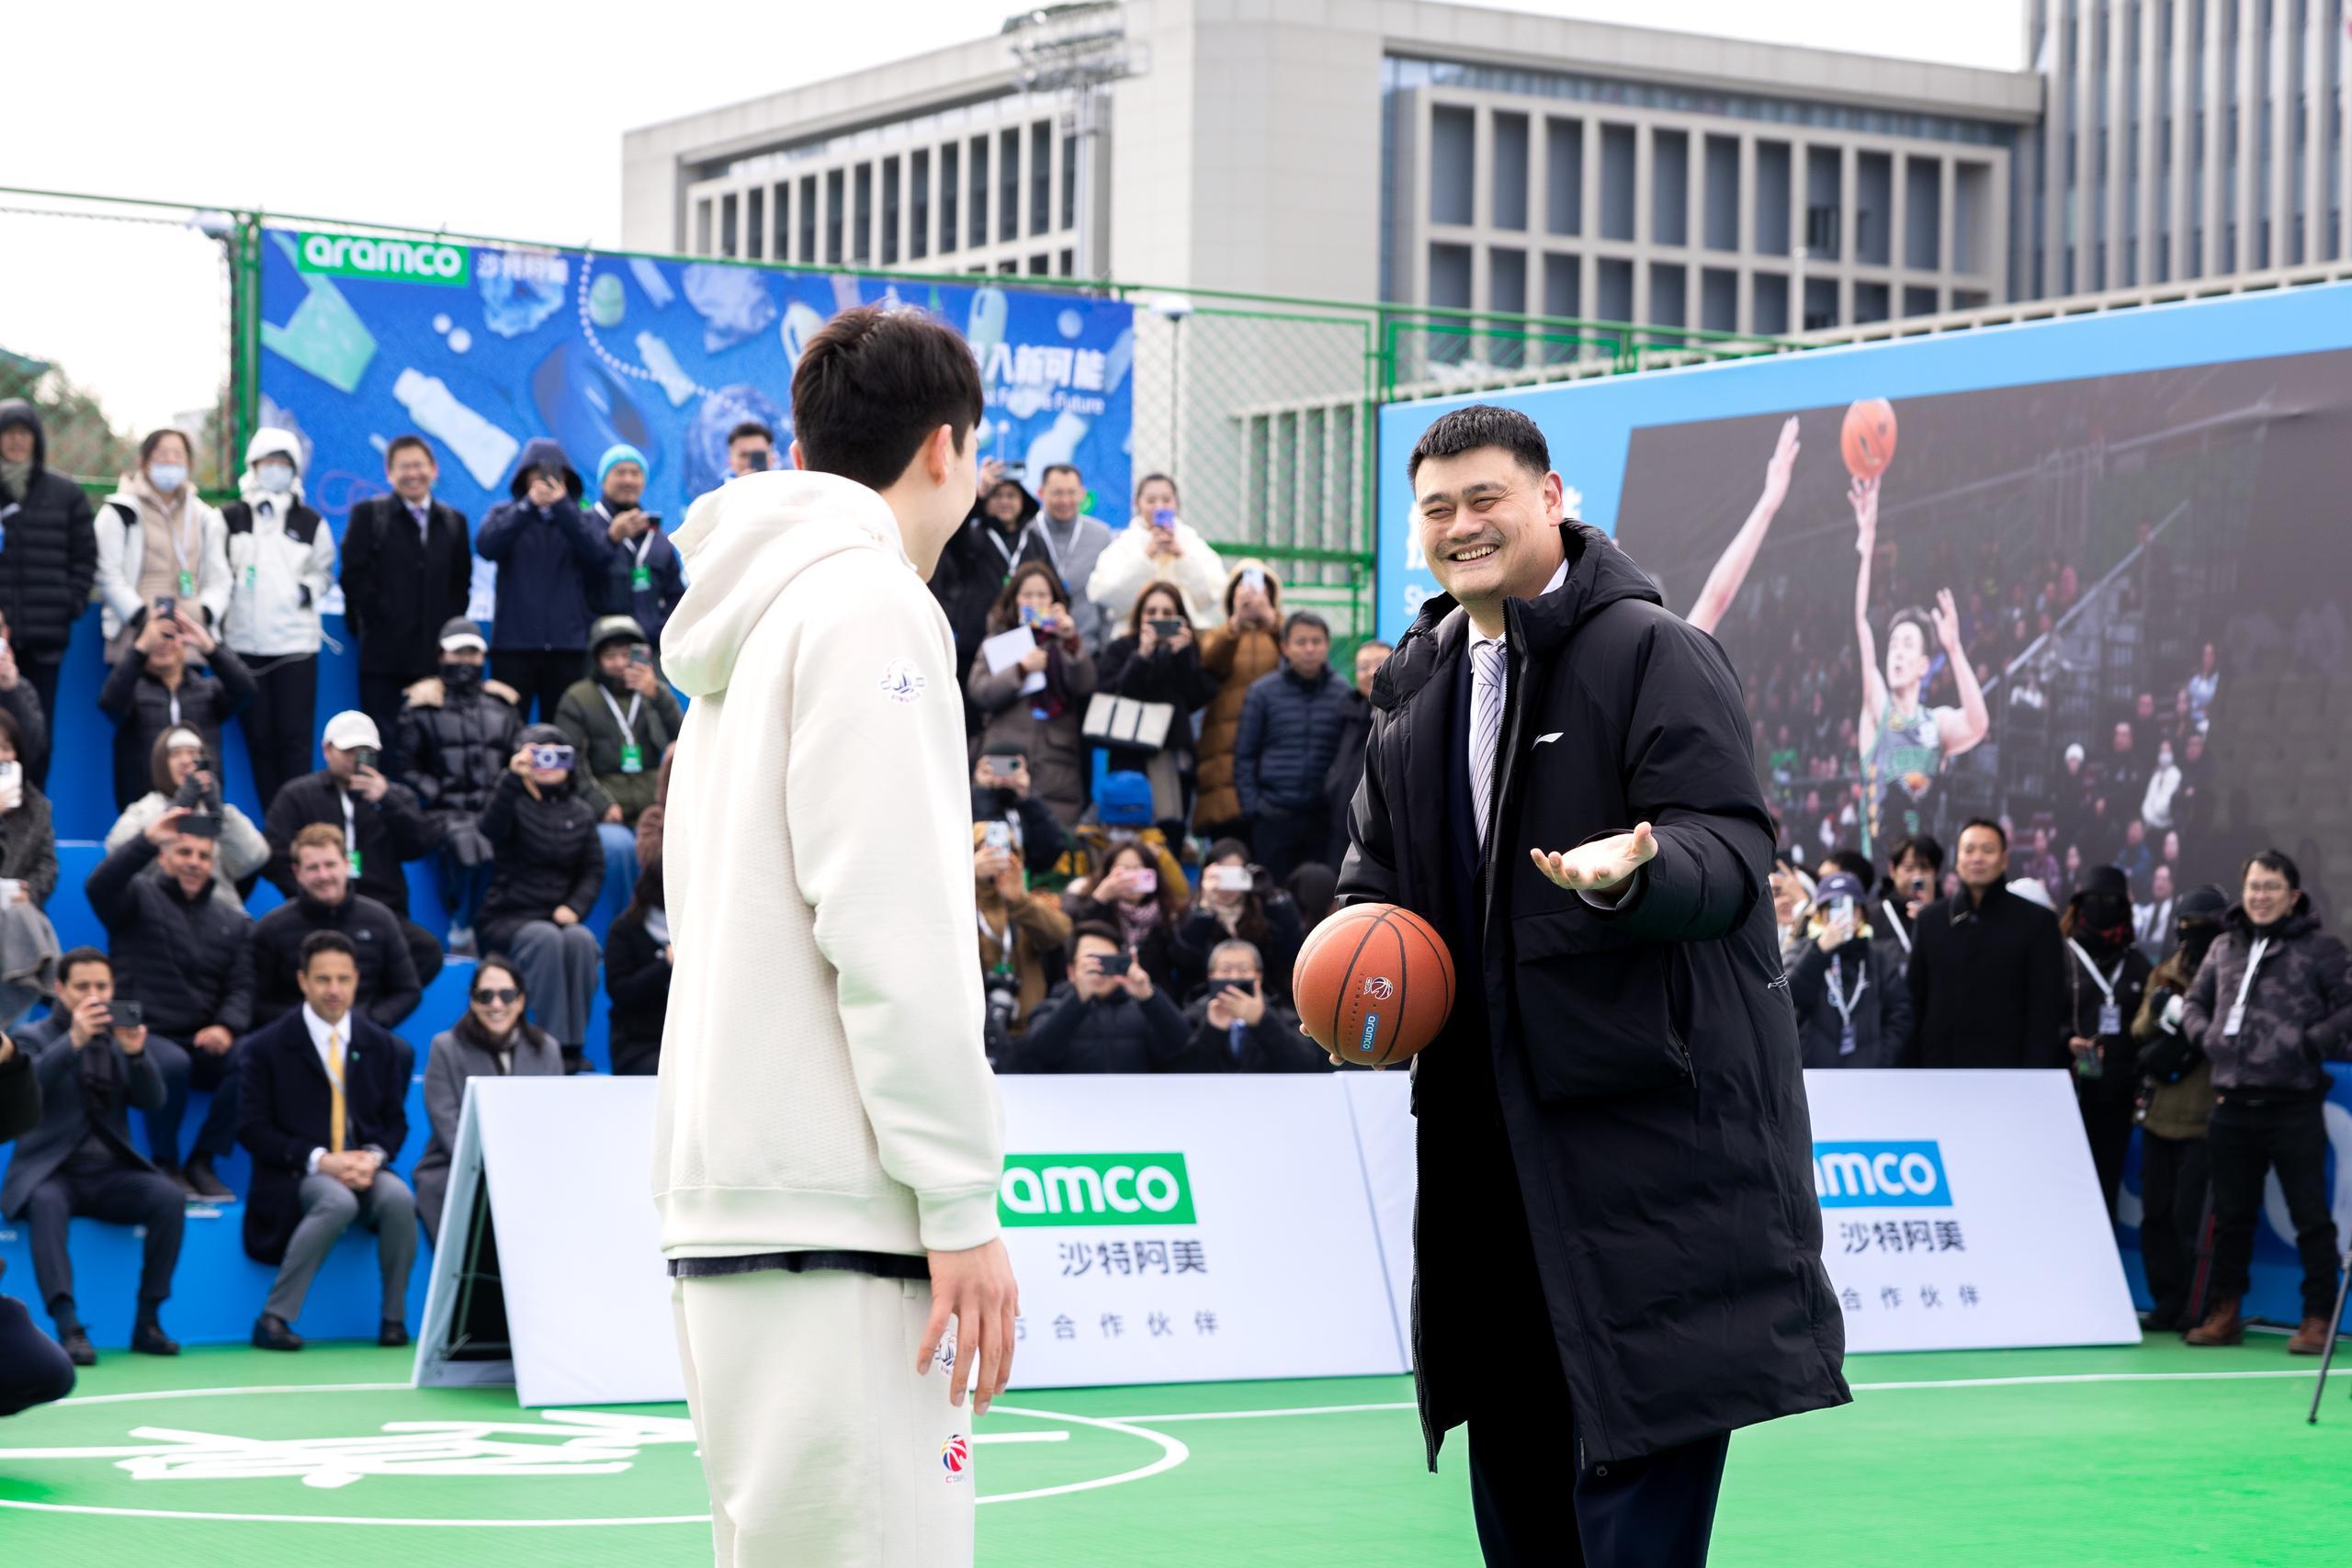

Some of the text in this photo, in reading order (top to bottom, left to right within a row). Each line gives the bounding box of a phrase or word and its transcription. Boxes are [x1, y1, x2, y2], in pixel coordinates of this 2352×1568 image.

[304, 235, 462, 277] aramco
[1363, 1015, 1376, 1050] aramco
[1839, 1220, 1966, 1253] 沙特阿美
[1058, 1240, 1208, 1276] 沙特阿美
